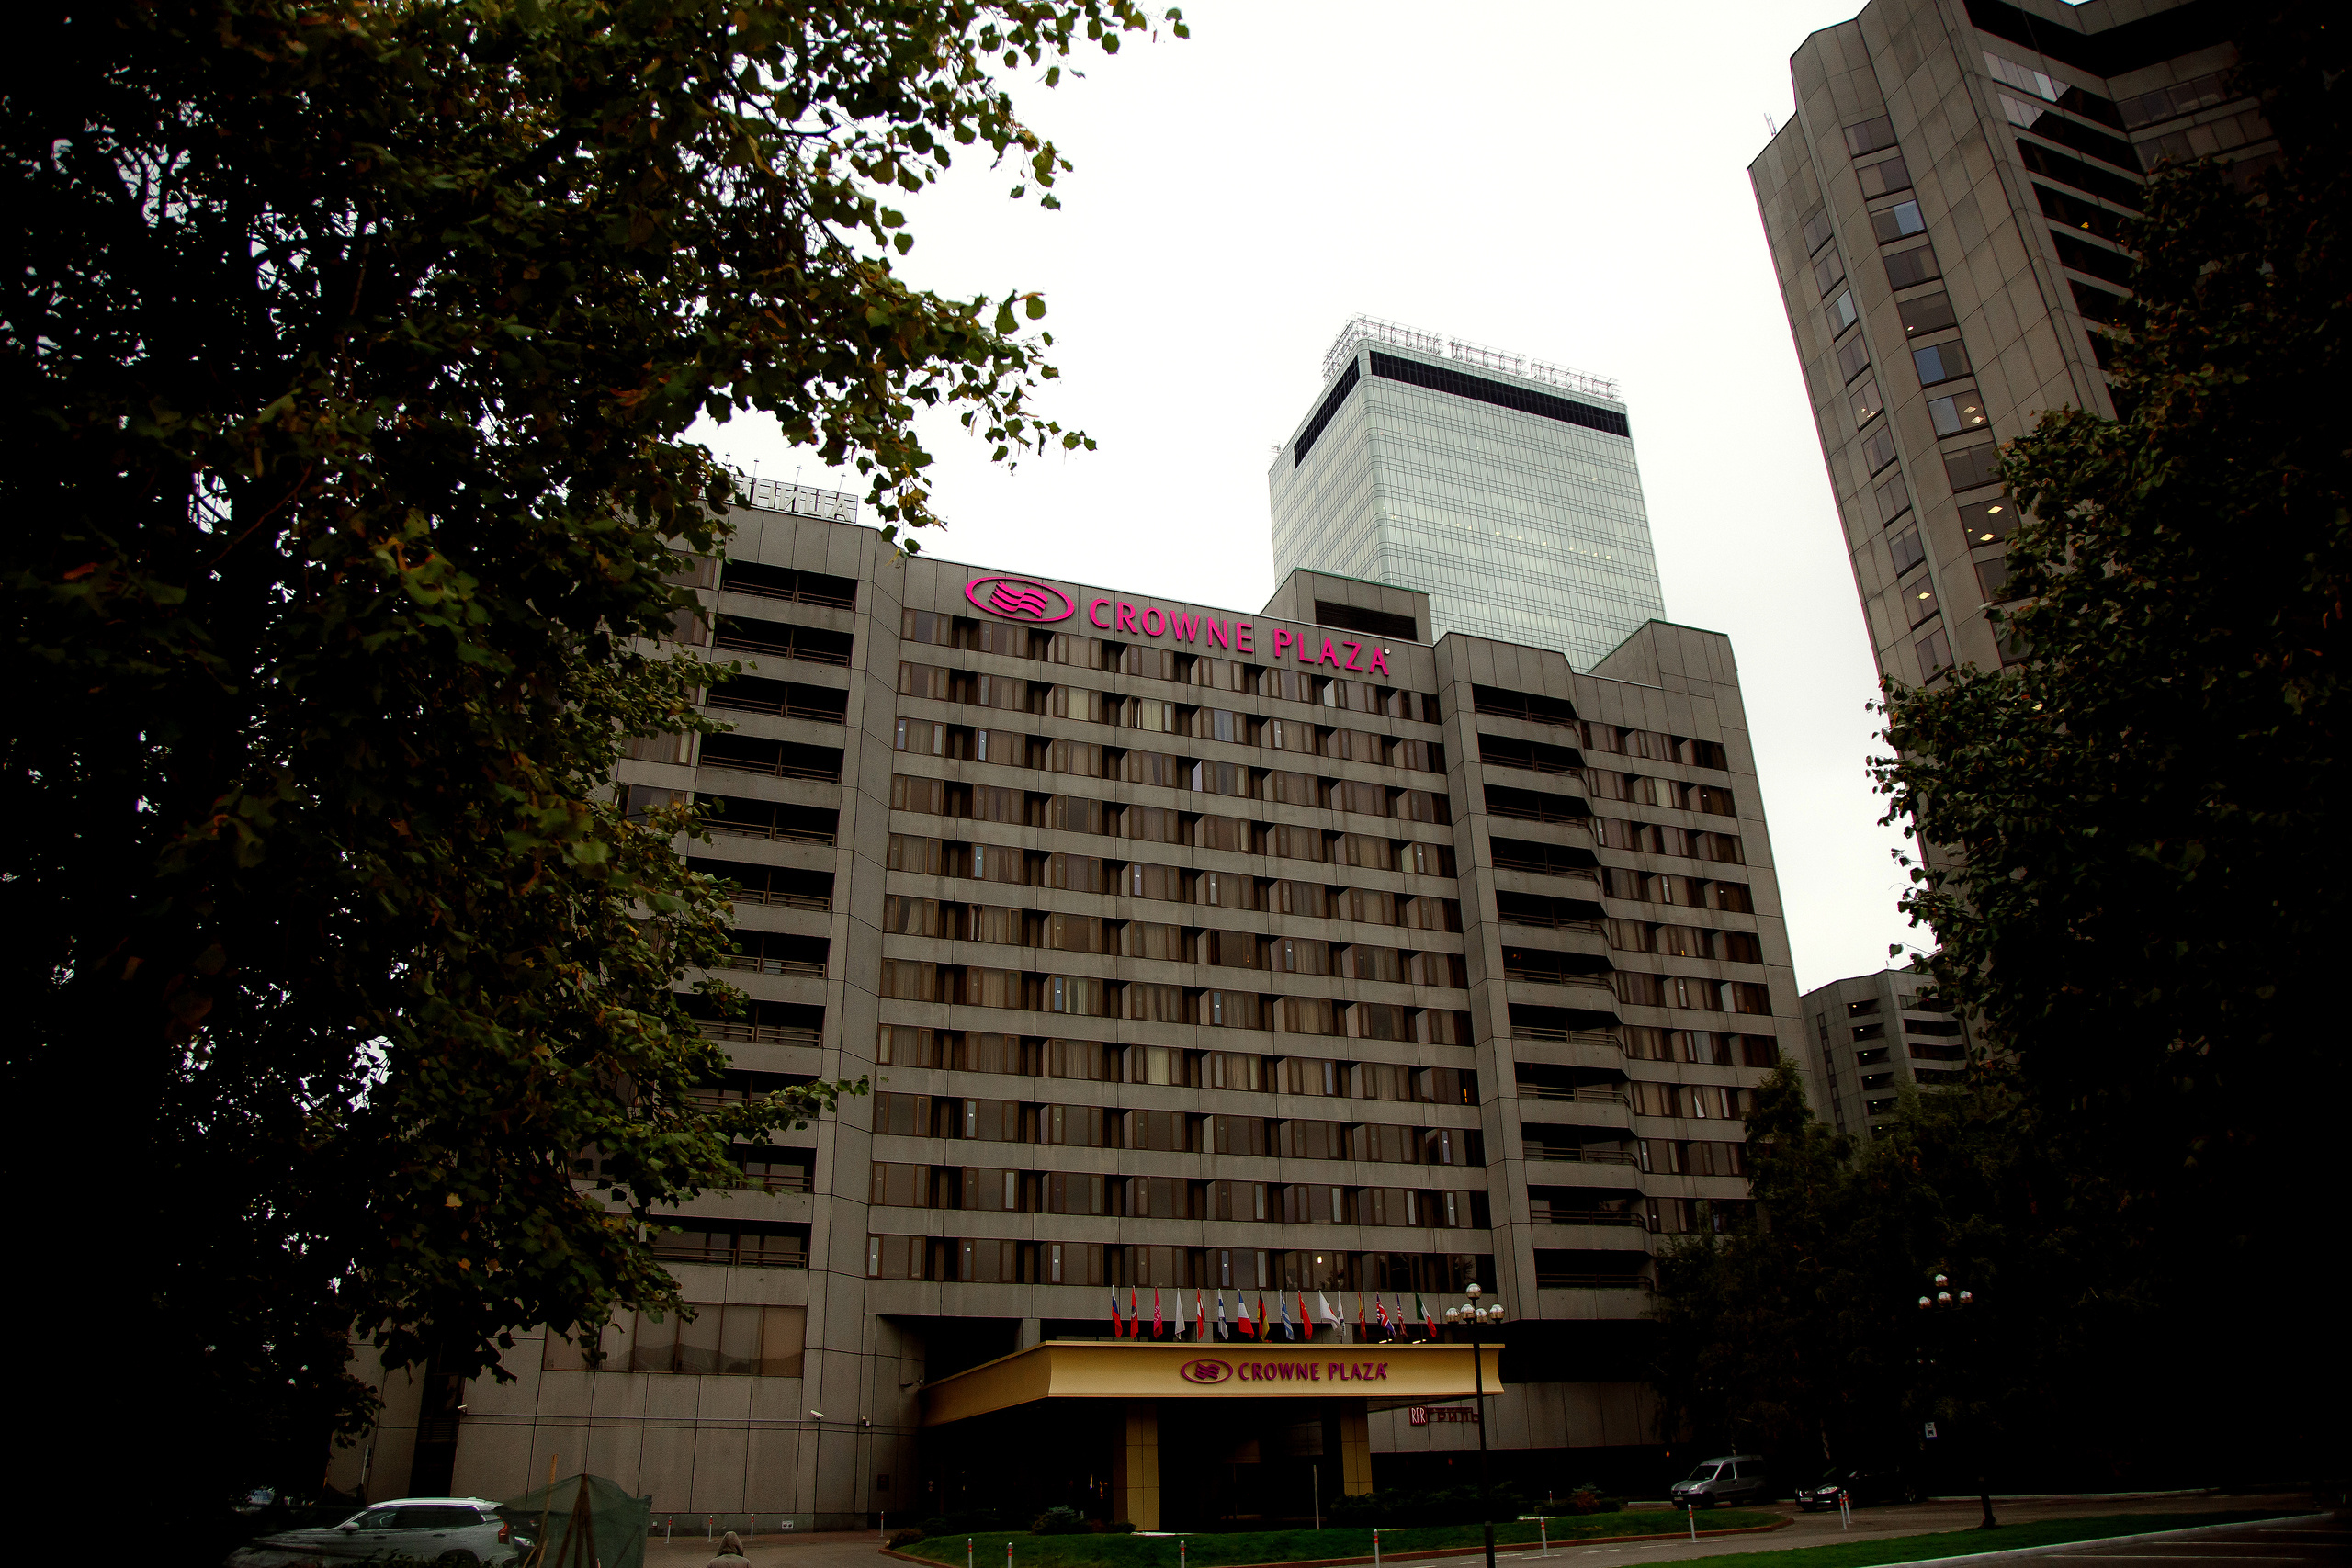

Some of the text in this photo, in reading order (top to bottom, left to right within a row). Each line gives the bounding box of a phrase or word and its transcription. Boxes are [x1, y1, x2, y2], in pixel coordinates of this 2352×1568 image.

[1089, 598, 1390, 677] CROWNE PLAZA
[1238, 1362, 1388, 1381] CROWNE PLAZA
[1410, 1406, 1426, 1424] RFR
